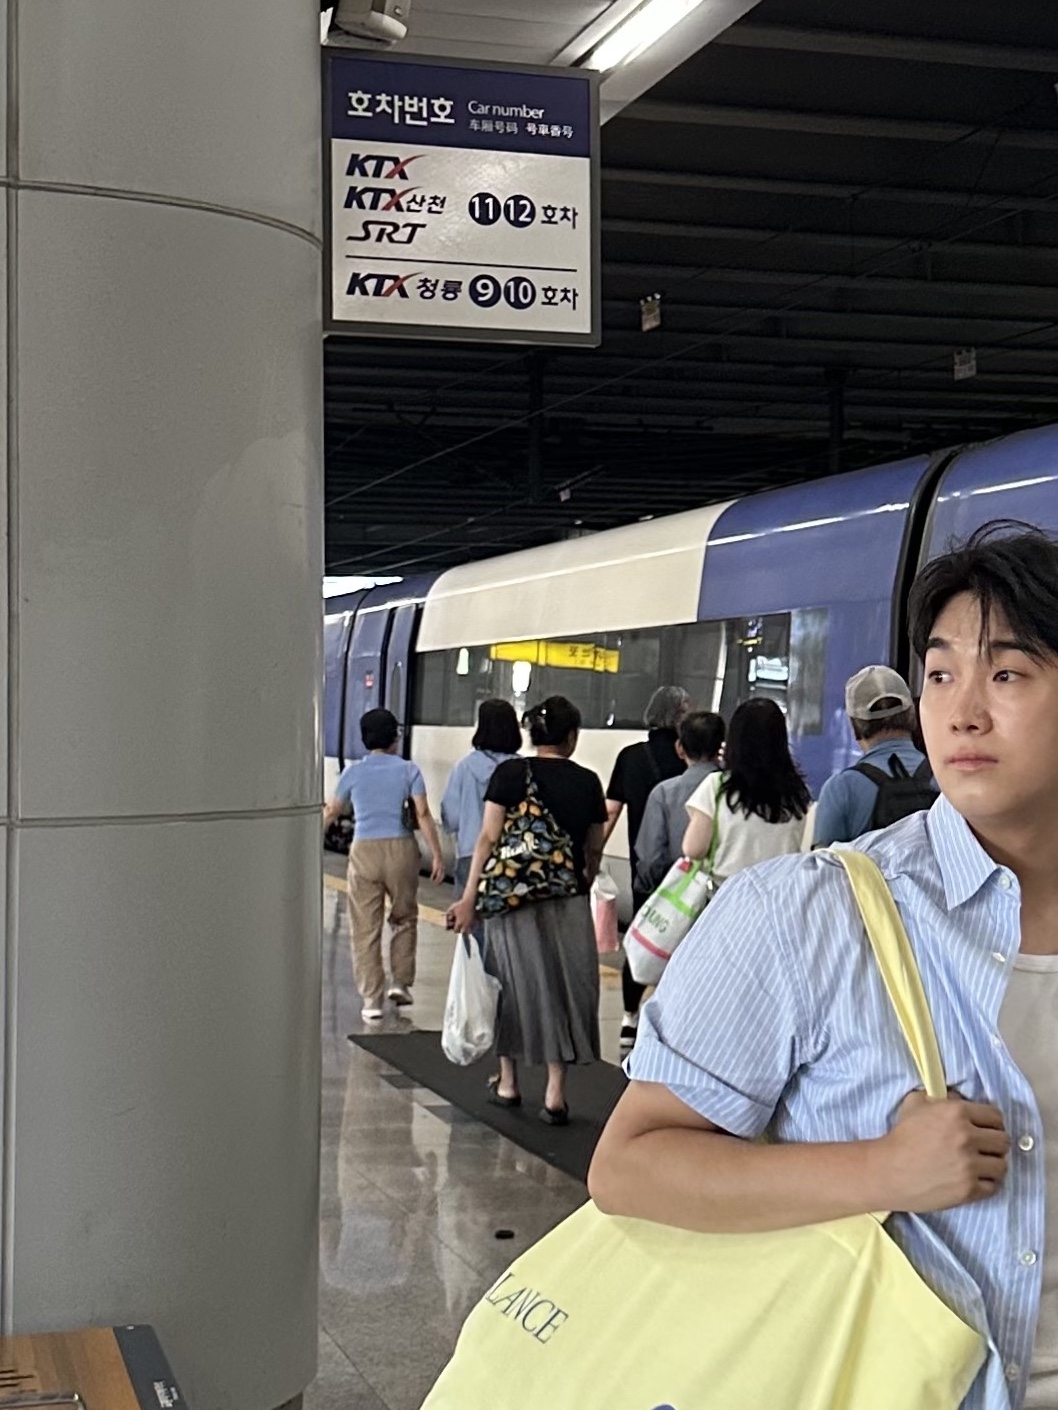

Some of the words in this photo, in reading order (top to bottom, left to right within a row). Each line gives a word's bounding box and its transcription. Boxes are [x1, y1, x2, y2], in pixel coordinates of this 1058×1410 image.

[347, 90, 455, 126] 호차번호
[468, 100, 490, 114] Car
[492, 104, 545, 119] number
[345, 153, 428, 181] KTX
[470, 196, 496, 221] 11
[506, 198, 533, 224] 12
[540, 204, 578, 229] 호차
[345, 220, 427, 244] SRT
[345, 272, 425, 299] KTX
[416, 277, 463, 301] 청룡
[474, 276, 496, 304] 9
[505, 279, 534, 306] 10
[541, 286, 578, 311] 호차
[485, 1272, 569, 1344] LANCE
